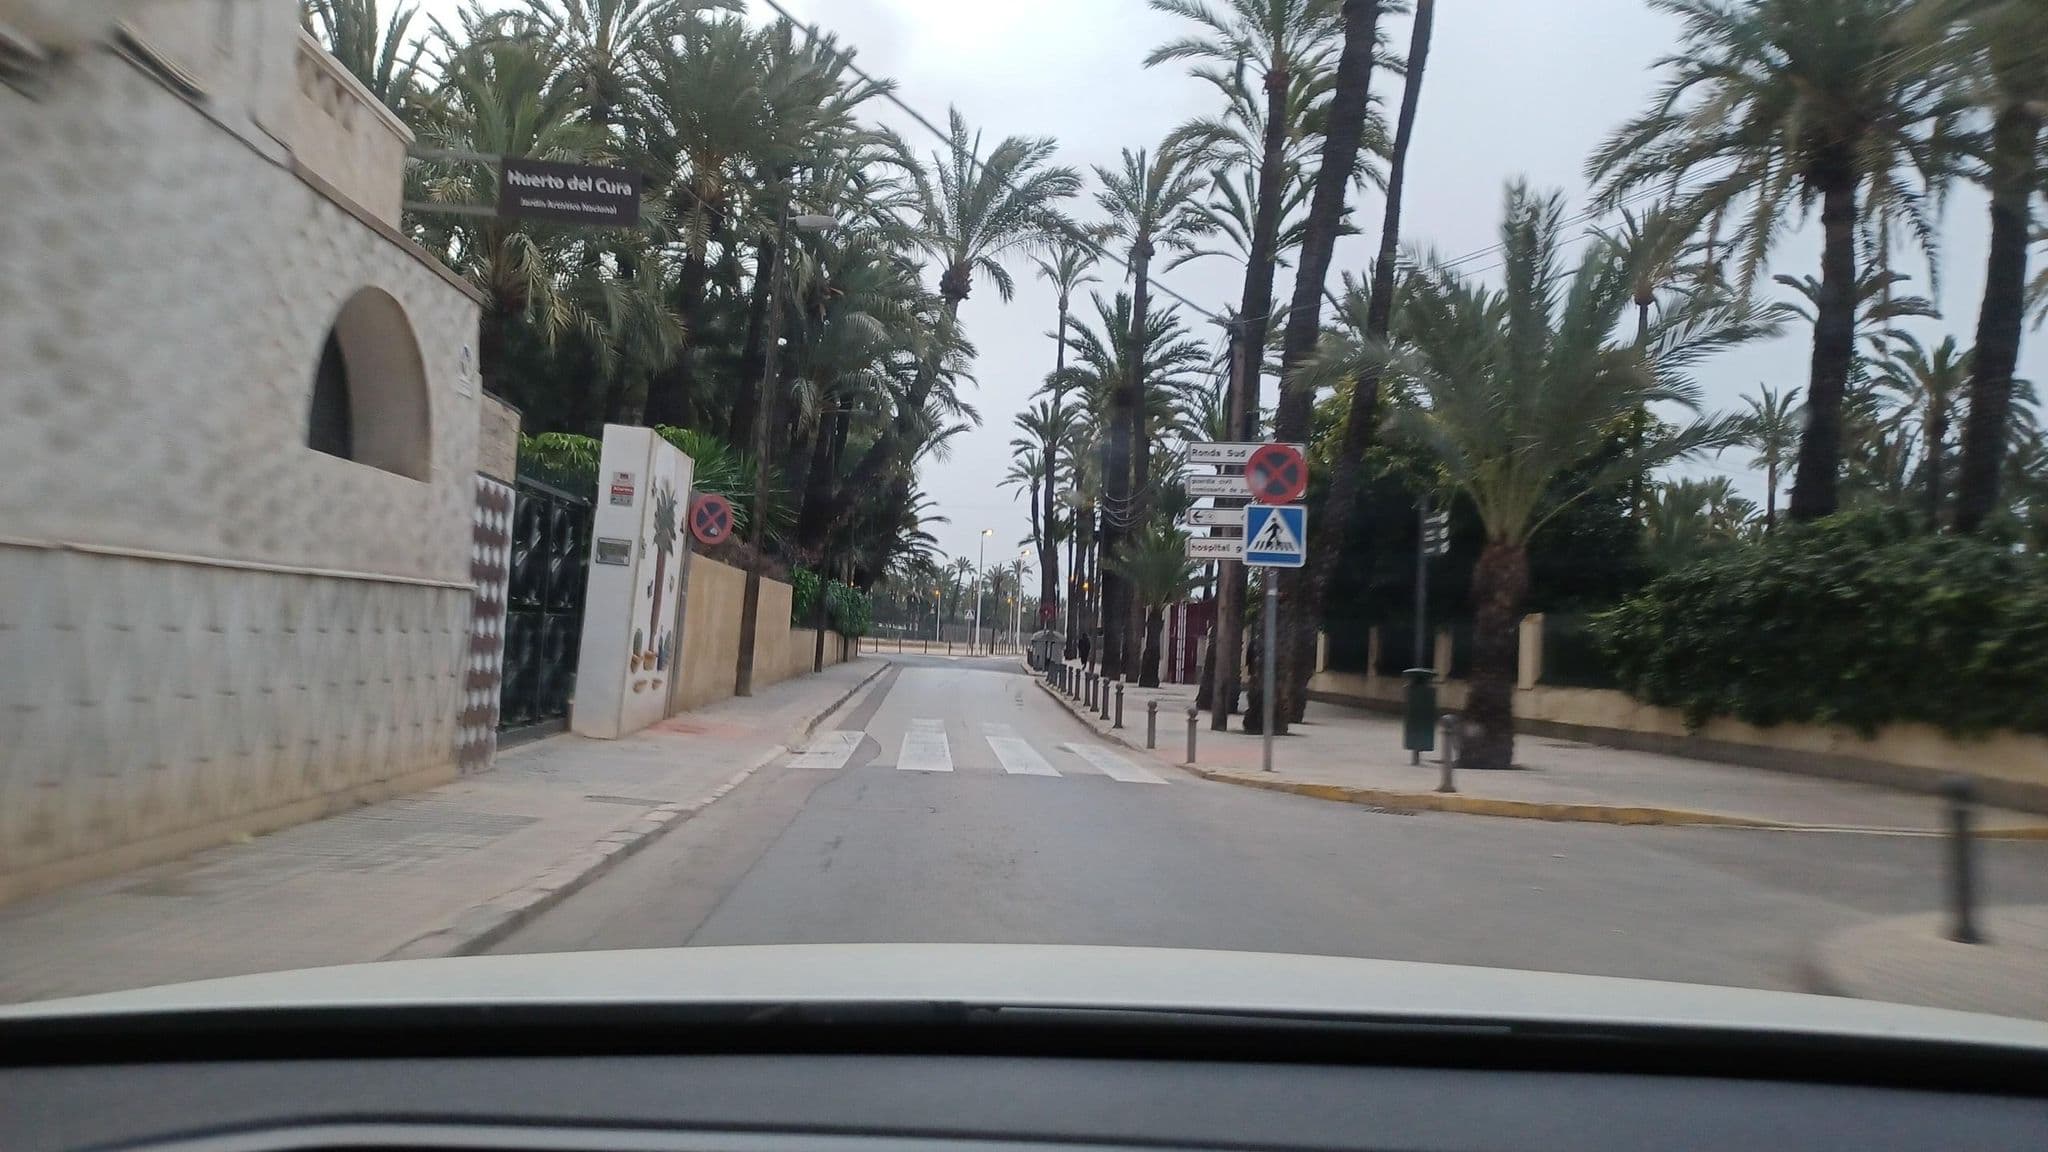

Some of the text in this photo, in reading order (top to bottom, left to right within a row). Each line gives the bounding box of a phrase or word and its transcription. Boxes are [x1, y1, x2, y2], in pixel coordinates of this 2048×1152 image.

[507, 169, 633, 196] Huerto del Cura
[582, 202, 618, 215] Nacional
[1192, 448, 1247, 458] Ronda Sud
[1191, 544, 1230, 553] hospital
